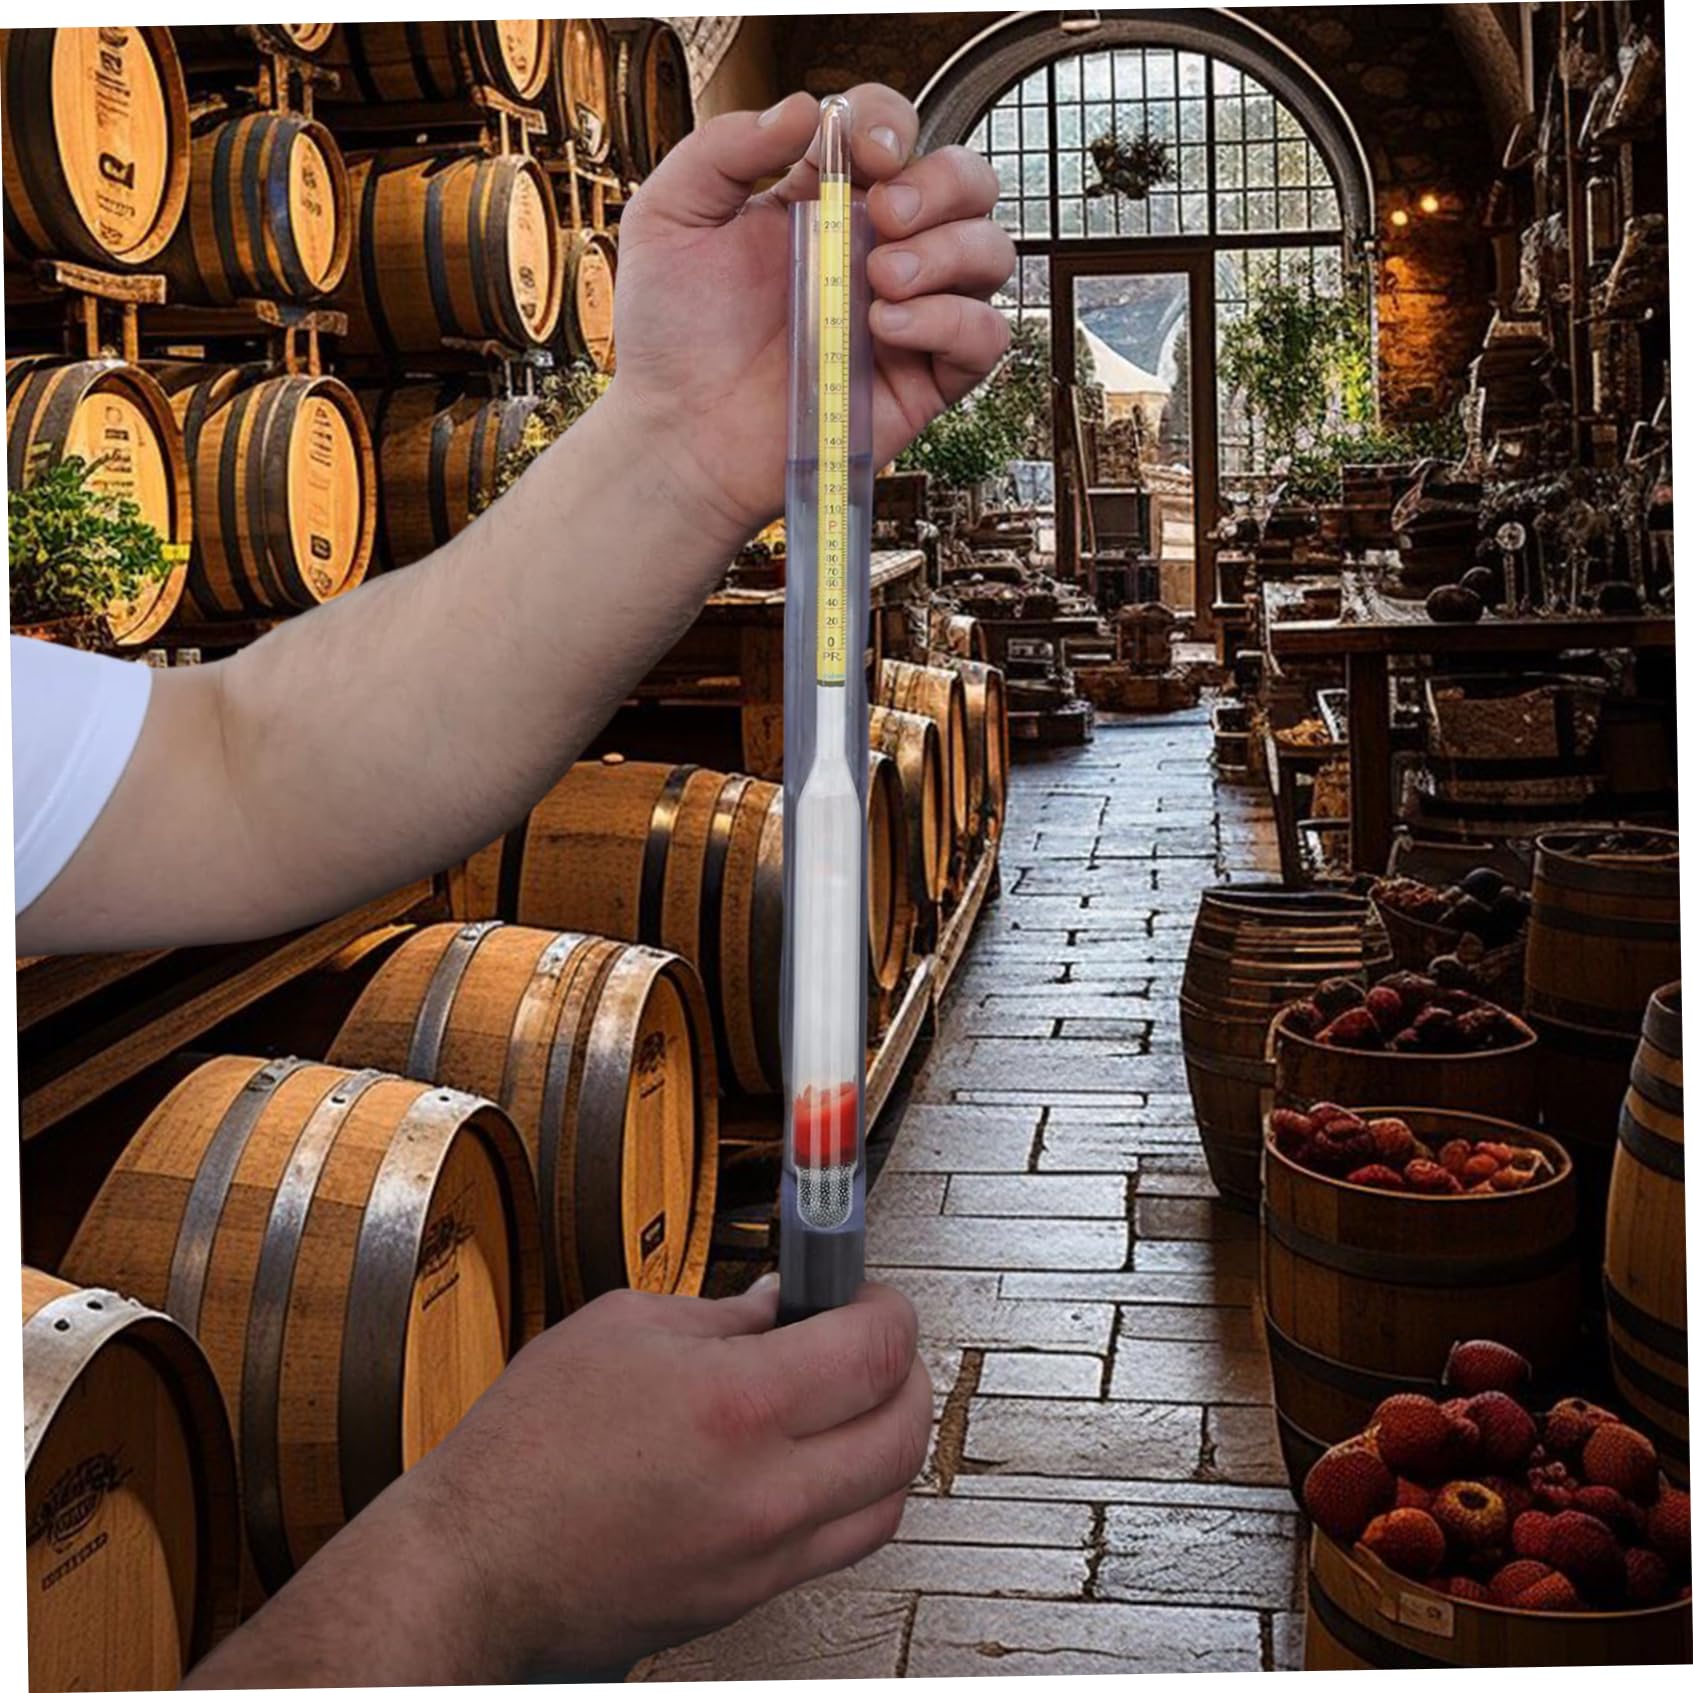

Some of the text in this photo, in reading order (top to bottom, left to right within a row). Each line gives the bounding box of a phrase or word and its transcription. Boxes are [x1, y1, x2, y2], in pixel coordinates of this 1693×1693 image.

[824, 352, 842, 361] 170
[824, 383, 842, 392] 160
[824, 437, 842, 446] 140
[824, 461, 842, 470] 130
[824, 484, 842, 493] 120
[824, 504, 842, 514] 110
[825, 567, 839, 576] 70
[825, 598, 839, 607] 40
[825, 616, 839, 625] 20
[827, 636, 835, 647] 0
